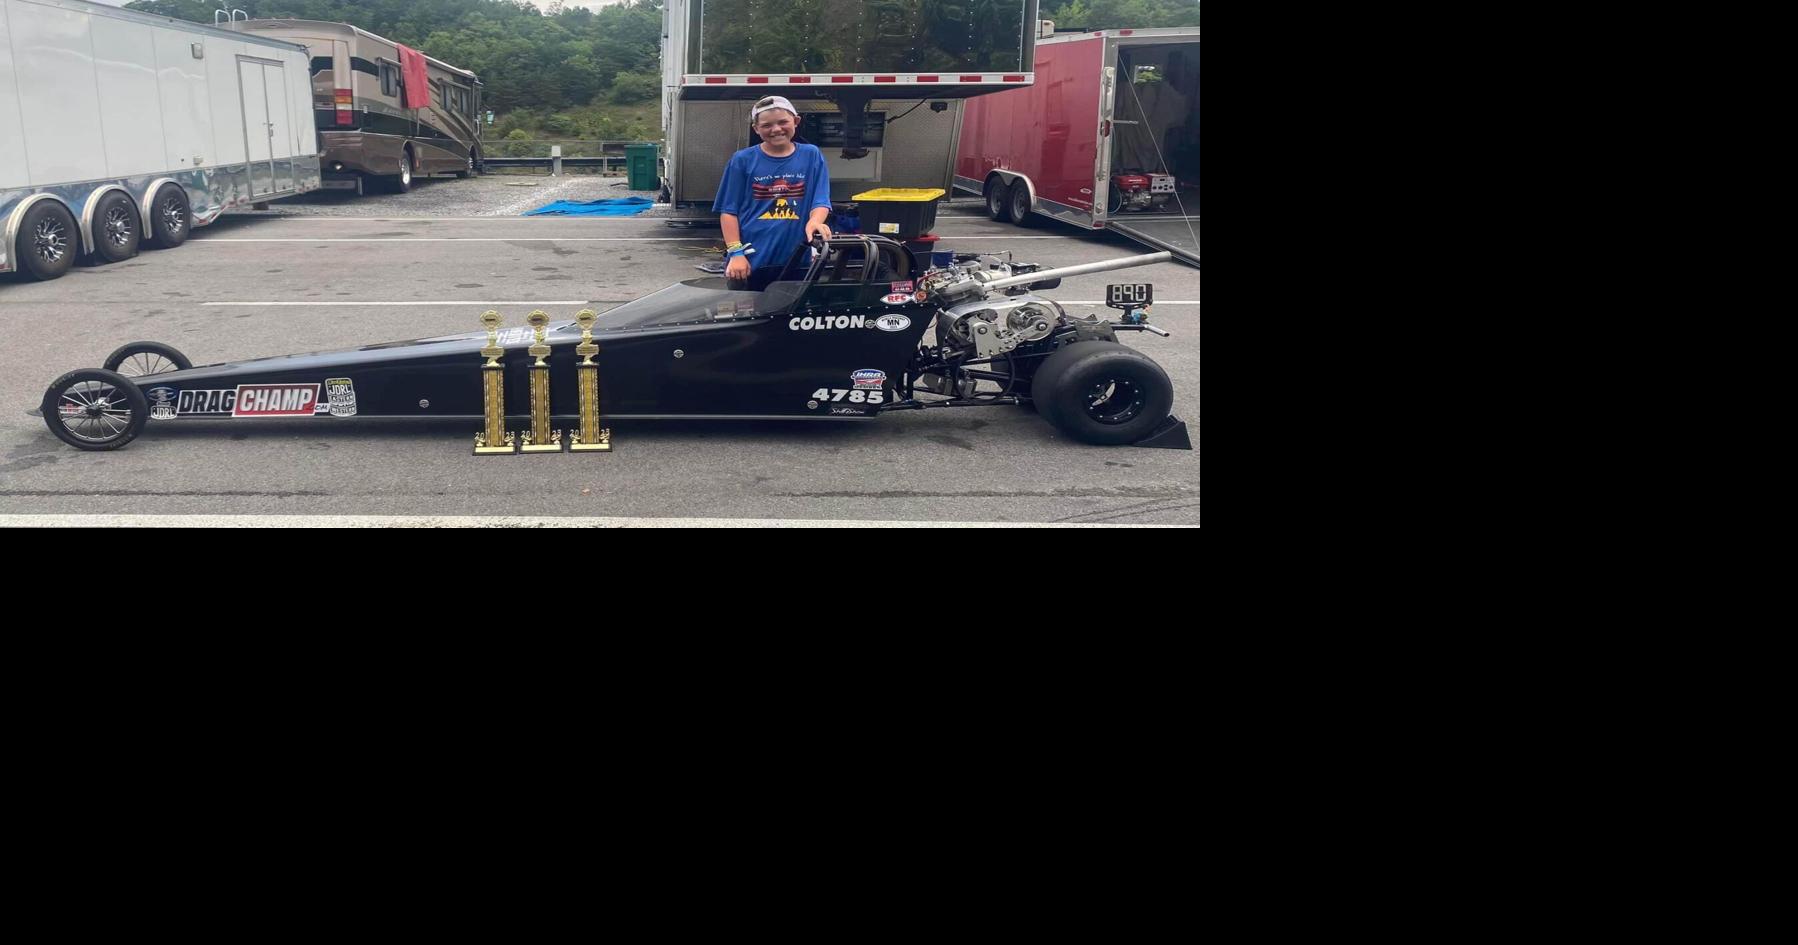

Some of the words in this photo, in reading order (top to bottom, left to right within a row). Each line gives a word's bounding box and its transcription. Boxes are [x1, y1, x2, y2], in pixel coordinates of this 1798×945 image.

[887, 294, 906, 303] RFC
[1112, 284, 1147, 302] 890
[789, 315, 865, 331] COLTON
[329, 384, 351, 395] JDRL
[812, 387, 884, 405] 4785
[179, 390, 237, 413] DRAG
[240, 388, 314, 412] CHAMP
[154, 406, 176, 418] JDRL
